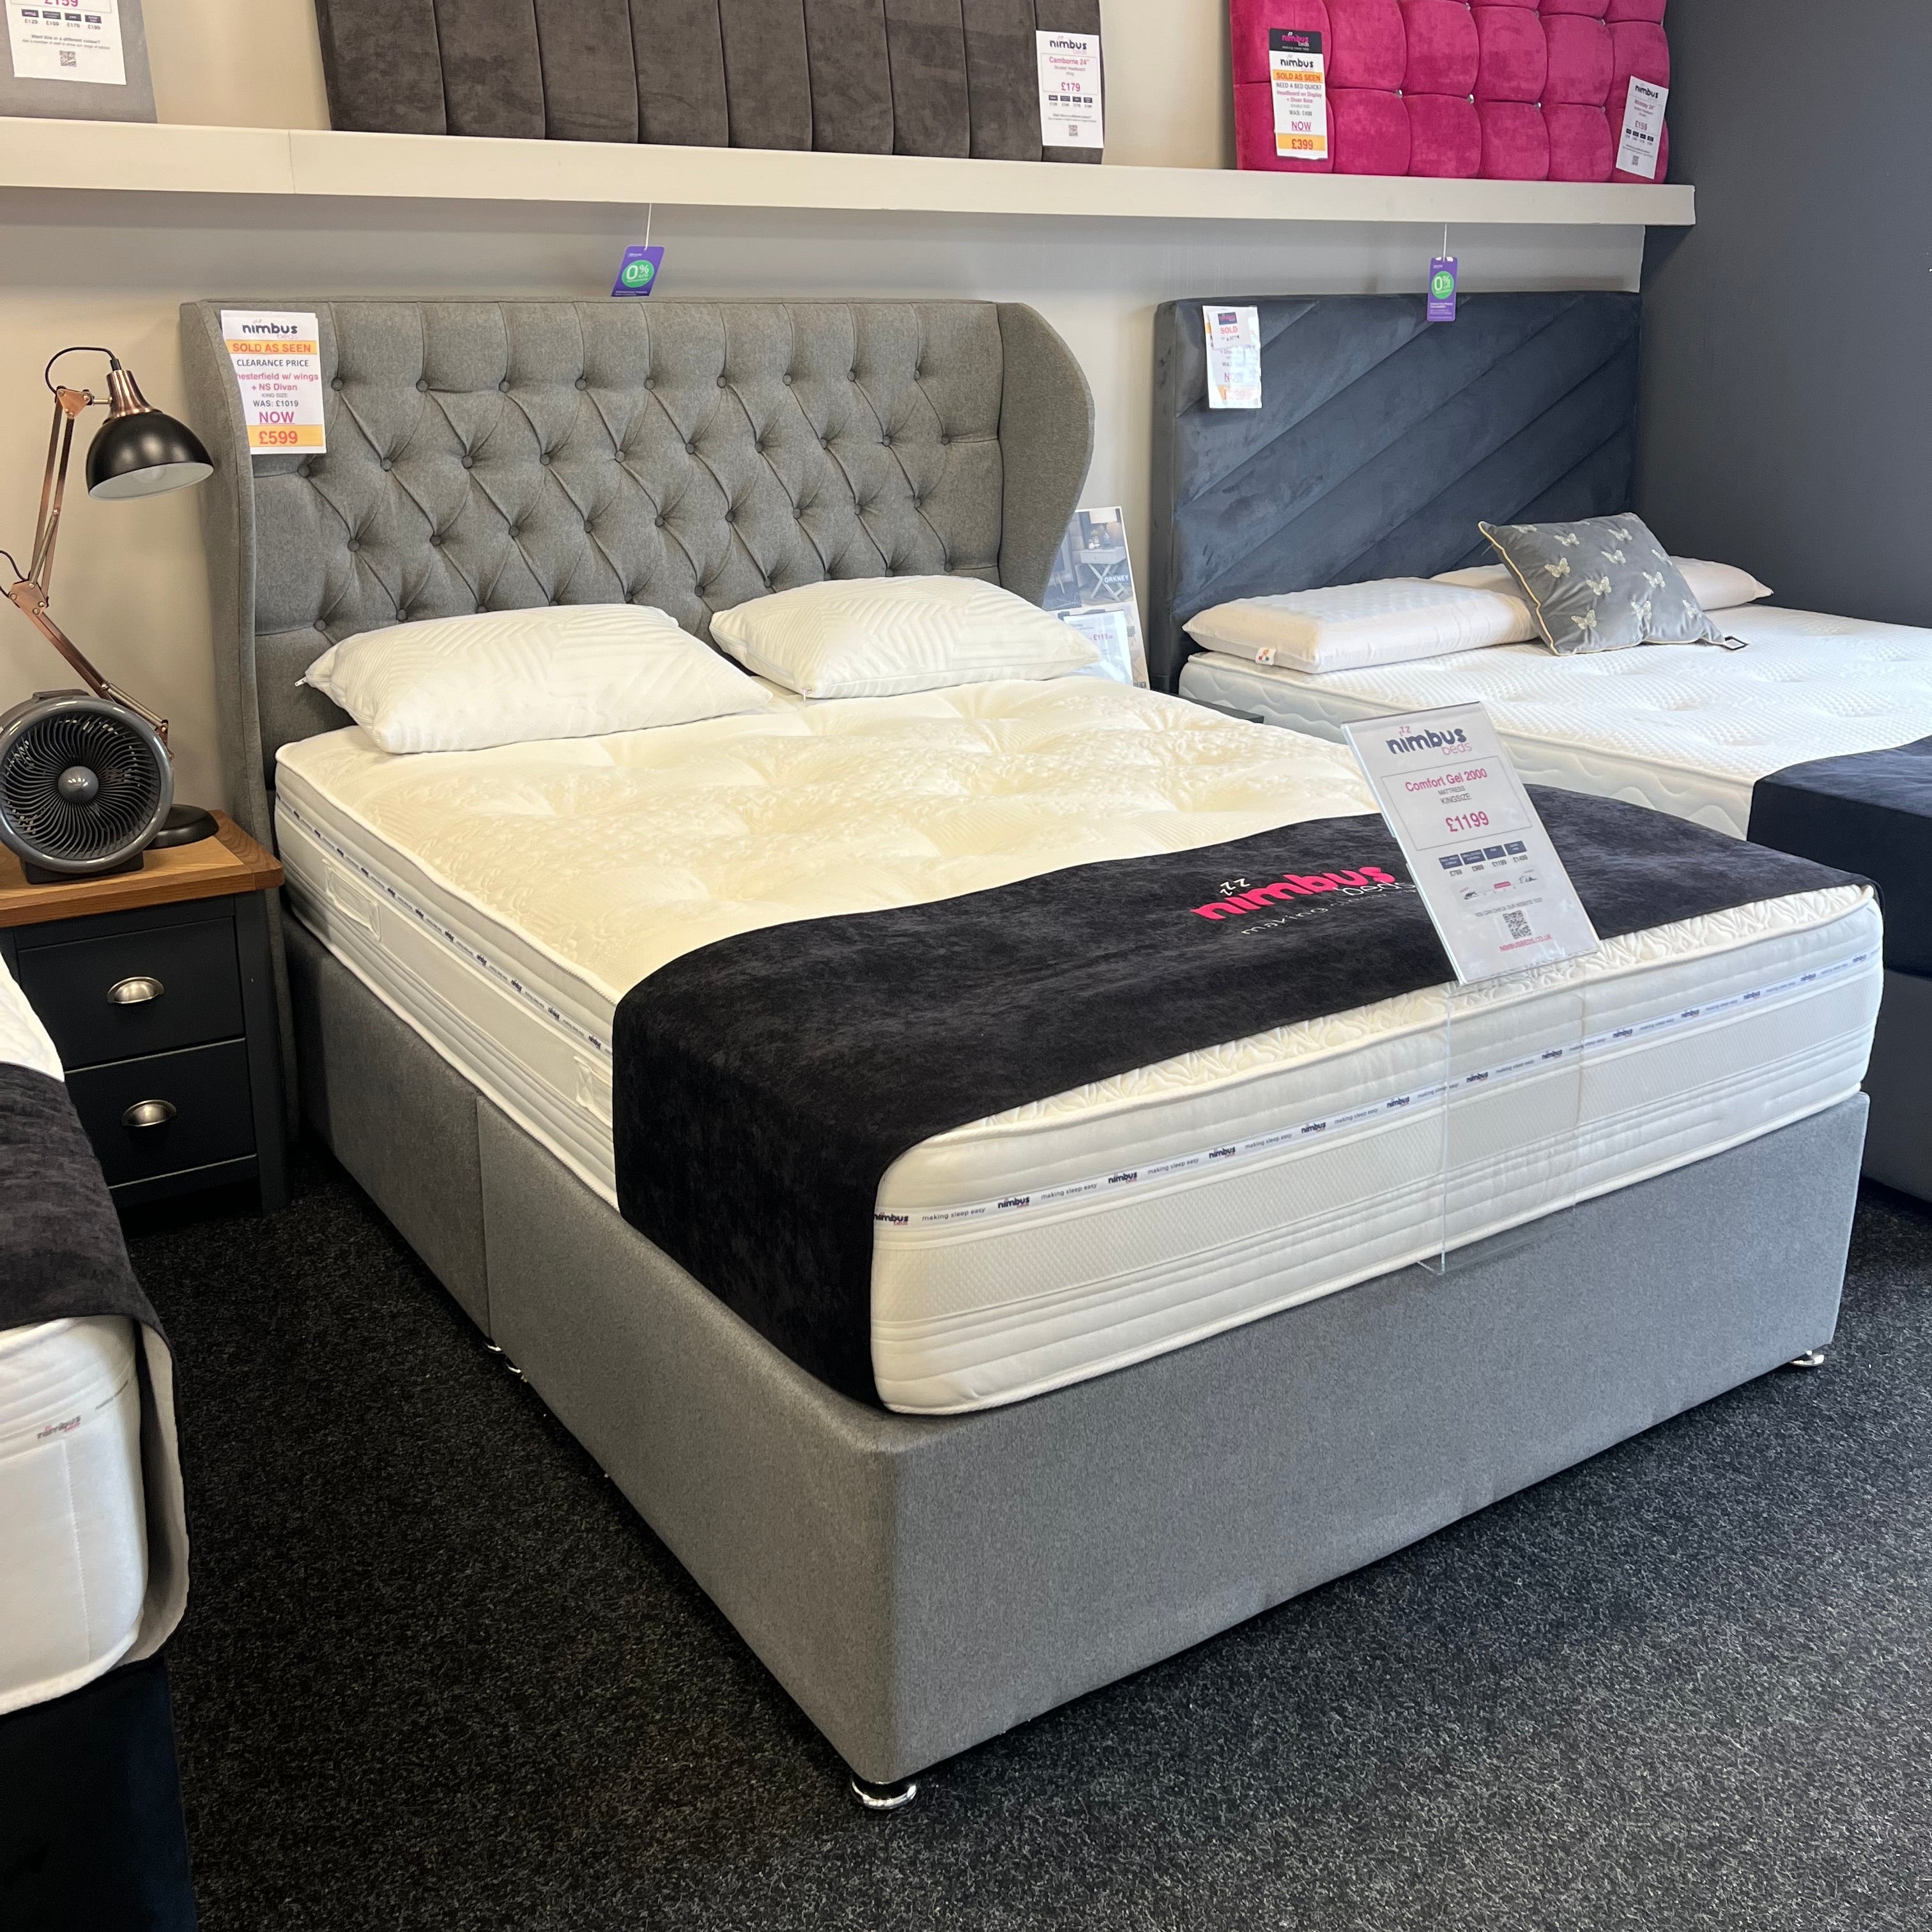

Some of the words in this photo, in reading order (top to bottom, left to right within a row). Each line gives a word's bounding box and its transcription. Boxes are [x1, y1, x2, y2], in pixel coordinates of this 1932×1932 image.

[1050, 40, 1087, 50] nimbus
[1049, 56, 1078, 65] Camborne
[1280, 58, 1314, 68] nimbus
[1276, 72, 1293, 80] SOLD
[1061, 82, 1080, 91] £179
[1292, 121, 1312, 131] NOW
[1291, 138, 1314, 150] £399
[242, 323, 298, 334] nimbus
[1220, 326, 1238, 334] SOLD
[233, 343, 261, 352] SOLD
[264, 344, 279, 352] AS
[282, 344, 311, 353] SEEN
[294, 373, 319, 382] wings
[259, 411, 295, 424] NOW
[259, 431, 299, 445] £599
[1104, 574, 1130, 584] ORKNEY
[1386, 728, 1467, 755] nimbus
[1441, 742, 1472, 755] beds
[1405, 775, 1446, 792] Comfort
[1446, 772, 1463, 785] Gel
[1464, 768, 1487, 781] 2000
[1438, 785, 1466, 795] MATTRESS
[1441, 793, 1472, 805] KINGSIZE
[1445, 811, 1489, 832] £1199
[1189, 866, 1396, 920] nimbus
[1333, 880, 1416, 896] beds
[1386, 1096, 1410, 1108] nimbus
[1301, 1122, 1326, 1134] nimbus
[1209, 1147, 1236, 1159] nimbus
[1245, 1140, 1265, 1149] making
[1266, 1136, 1279, 1146] sleep
[1280, 1133, 1292, 1142] easy
[1108, 1172, 1137, 1184] nimbus
[1147, 1165, 1169, 1174] making
[1170, 1162, 1185, 1170] sleep
[1186, 1158, 1199, 1167] easy
[997, 1196, 1030, 1209] nimbus
[1041, 1192, 1064, 1200] making
[1066, 1186, 1082, 1196] sleep
[1084, 1183, 1098, 1192] easy
[874, 1213, 909, 1223] nimbus
[922, 1213, 948, 1222] making
[951, 1210, 969, 1220] sleep
[970, 1207, 986, 1216] easy
